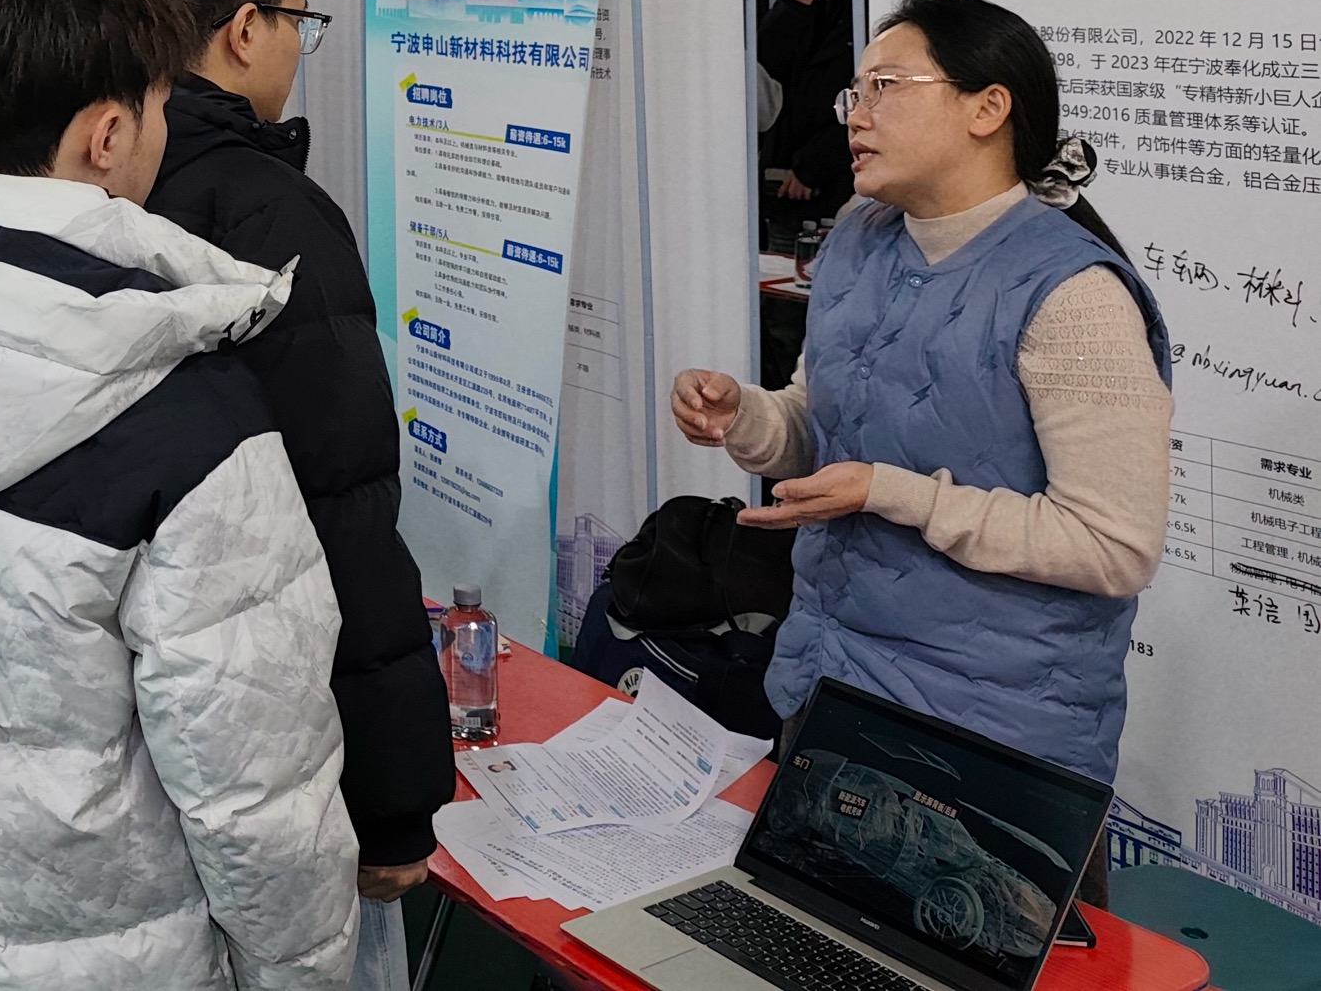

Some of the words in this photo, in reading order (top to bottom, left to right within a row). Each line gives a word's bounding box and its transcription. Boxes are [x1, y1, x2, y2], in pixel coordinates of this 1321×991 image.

[391, 31, 590, 72] 宁波申山新材料科技有限公司
[1155, 30, 1195, 45] 2022
[1199, 31, 1217, 47] 年
[1223, 32, 1242, 47] 12
[1248, 32, 1264, 49] 月
[1272, 33, 1293, 48] 15
[1301, 33, 1321, 51] 日
[1111, 55, 1149, 70] 2023
[1153, 55, 1321, 80] 年在宁波奉化成立三
[412, 86, 448, 105] 招聘岗位
[1134, 108, 1310, 137] 质量管理体系等认证。
[413, 321, 447, 345] 公司简介
[1168, 438, 1183, 451] 资
[1260, 457, 1313, 480] 需求专业
[1268, 487, 1306, 507] 机械类
[1250, 511, 1321, 540] 机械电子工程
[793, 755, 810, 770] 车门
[860, 916, 881, 931] HUAWEI
